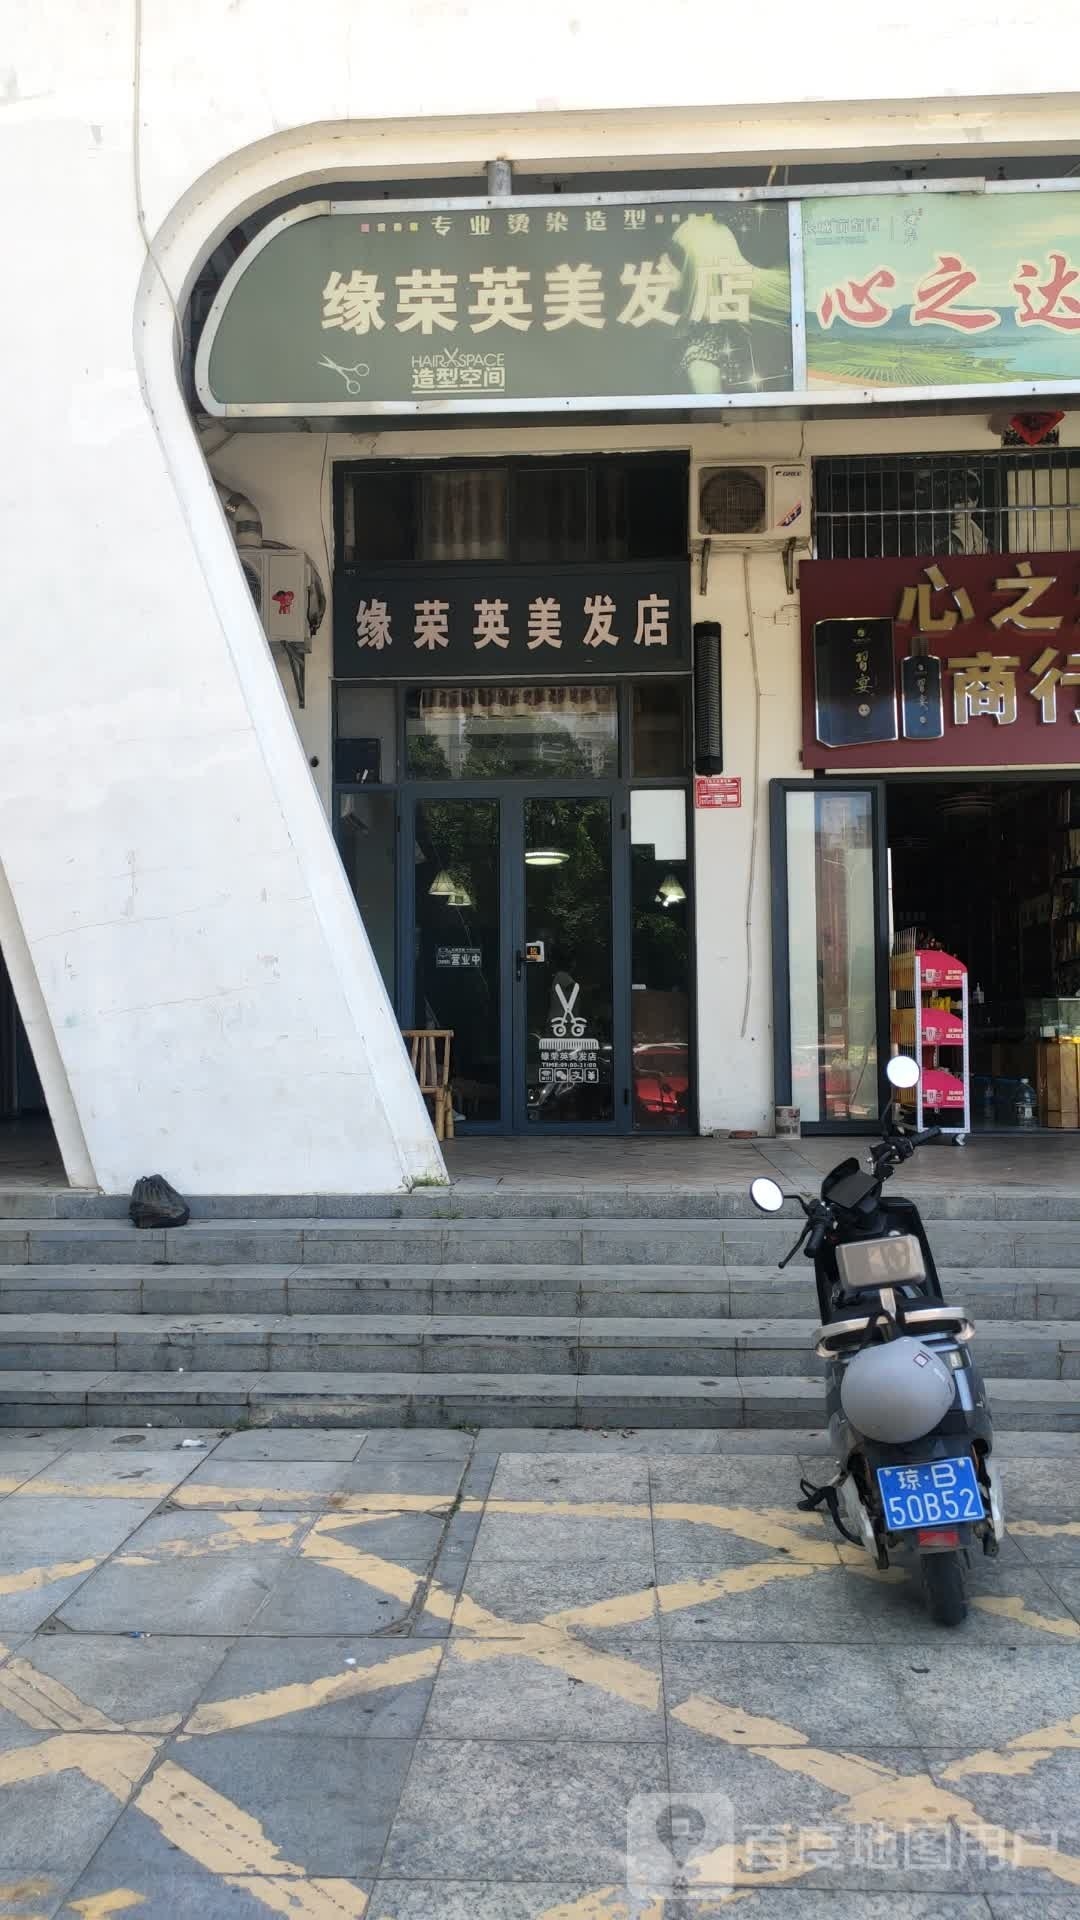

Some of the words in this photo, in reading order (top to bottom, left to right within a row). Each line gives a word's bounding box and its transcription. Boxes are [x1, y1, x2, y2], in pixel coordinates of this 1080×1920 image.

[431, 208, 647, 236] 专业烫染造型
[321, 253, 756, 335] 缘荣英美发店
[819, 252, 1080, 332] 心之达
[412, 367, 505, 388] 造型空间
[356, 594, 671, 650] 缘荣英美发店
[451, 953, 481, 966] 营业中
[888, 1488, 979, 1526] 50B52
